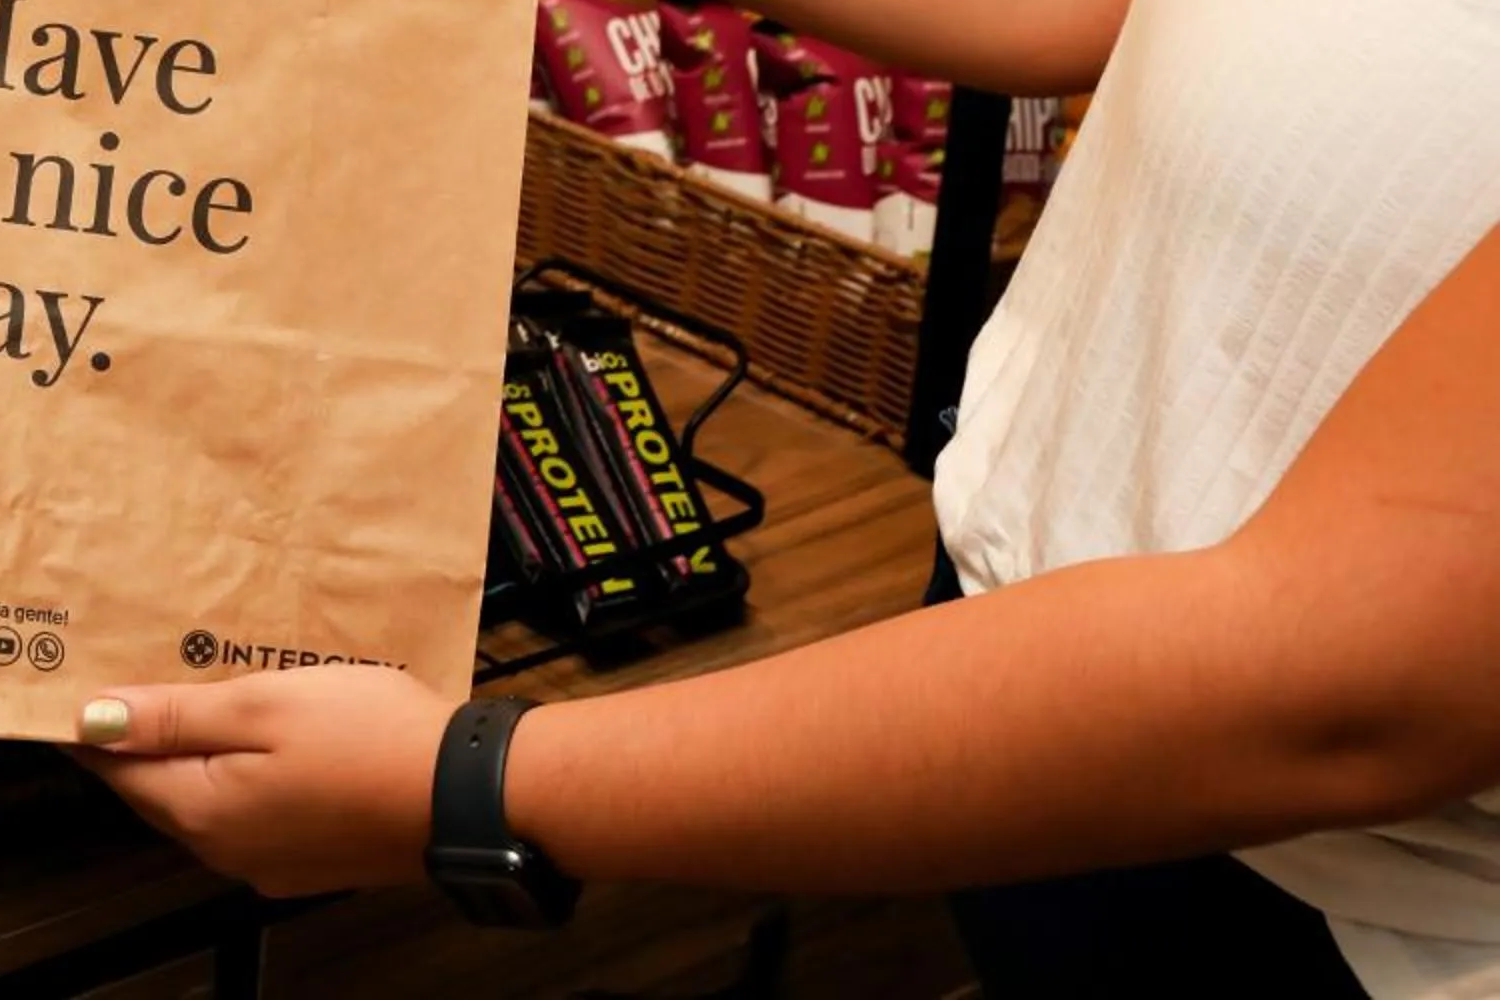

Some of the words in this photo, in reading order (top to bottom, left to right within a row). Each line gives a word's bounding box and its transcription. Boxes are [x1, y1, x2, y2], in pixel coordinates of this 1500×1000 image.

[1, 131, 254, 255] nice
[14, 606, 70, 627] gente!
[222, 639, 408, 671] INTER
